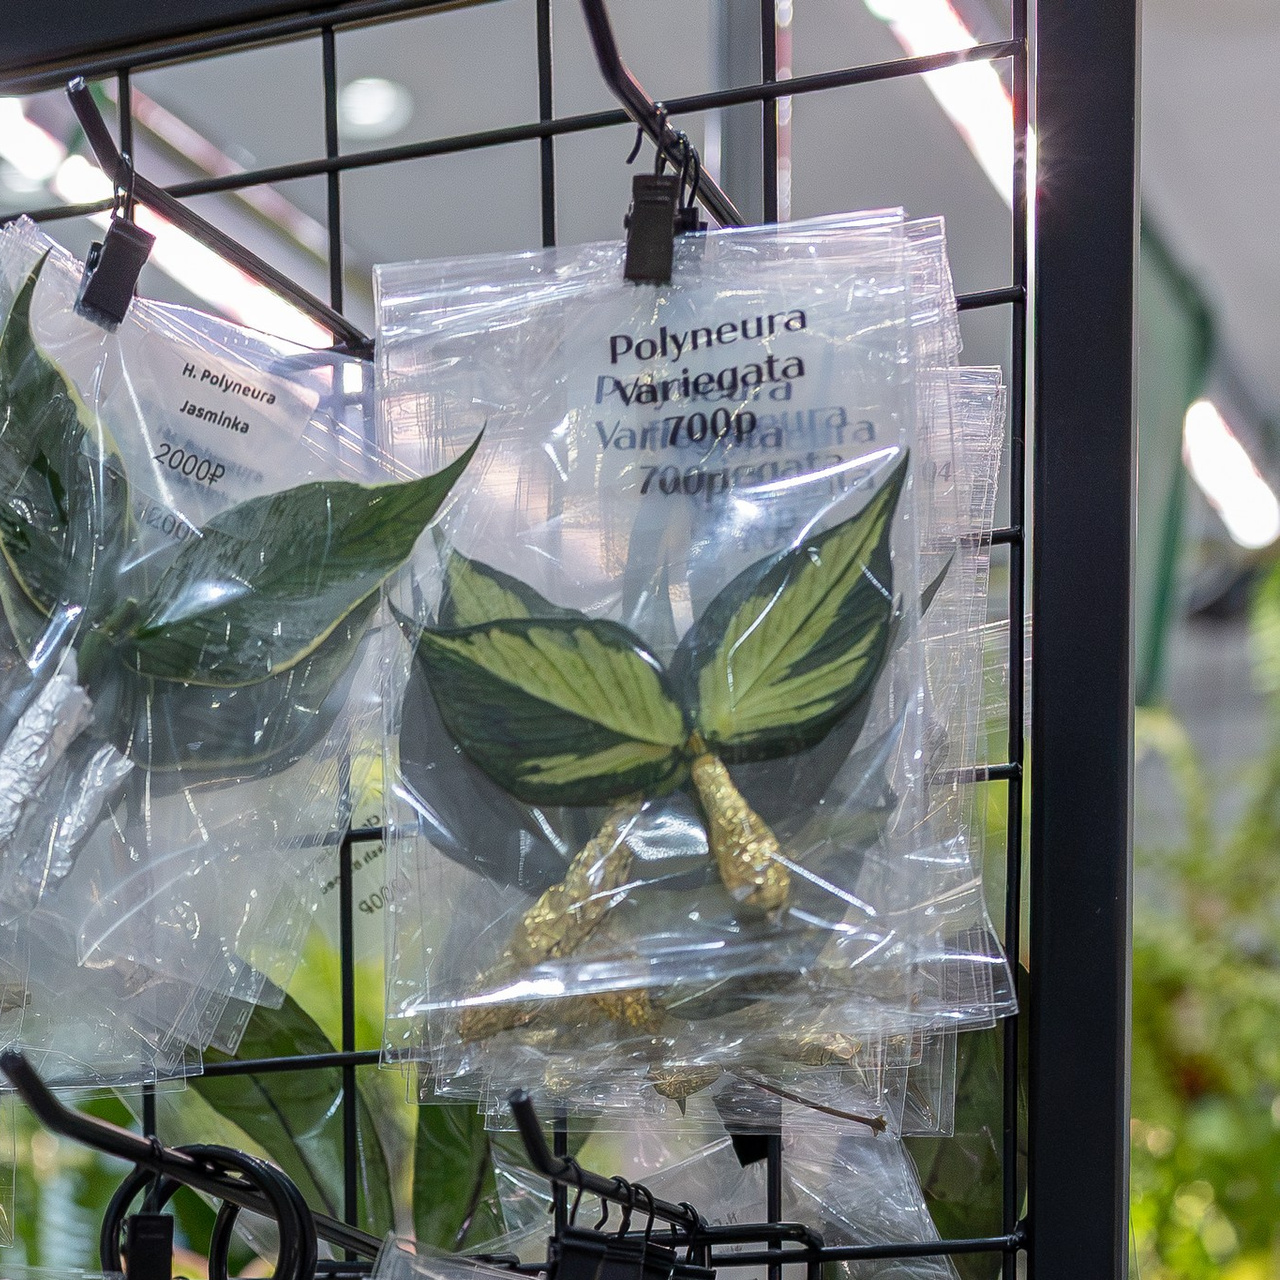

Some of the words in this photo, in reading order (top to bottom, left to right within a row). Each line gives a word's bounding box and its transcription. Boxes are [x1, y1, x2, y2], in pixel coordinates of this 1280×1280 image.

[609, 308, 808, 364] Polyneura
[182, 363, 196, 379] H.
[200, 369, 276, 405] Polyneura
[614, 354, 806, 406] Variegata
[179, 400, 250, 434] Jasminka
[665, 407, 757, 446] 700p
[152, 443, 226, 486] 2000₽
